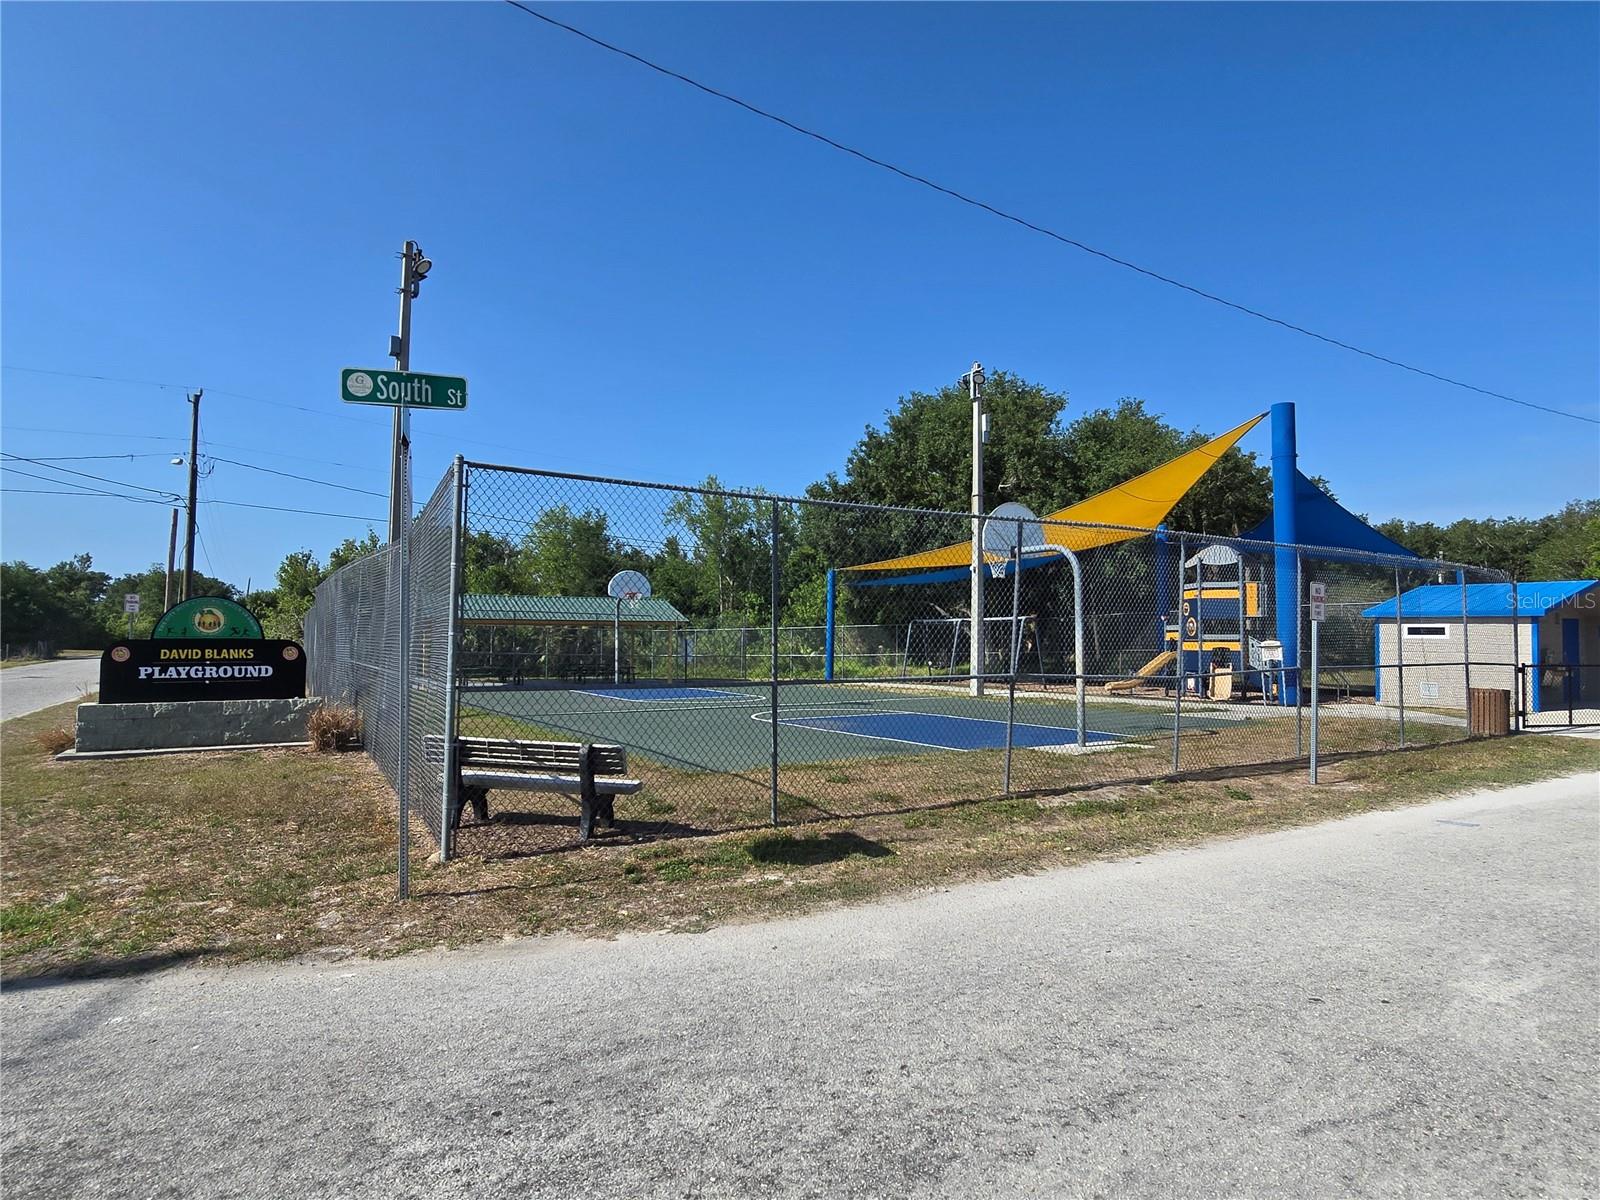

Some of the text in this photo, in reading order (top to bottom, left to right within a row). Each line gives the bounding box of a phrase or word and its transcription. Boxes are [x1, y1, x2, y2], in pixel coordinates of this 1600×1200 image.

[376, 374, 463, 406] South St
[160, 649, 254, 660] DAVID BLANKS
[138, 665, 273, 679] PLAYGROUND
